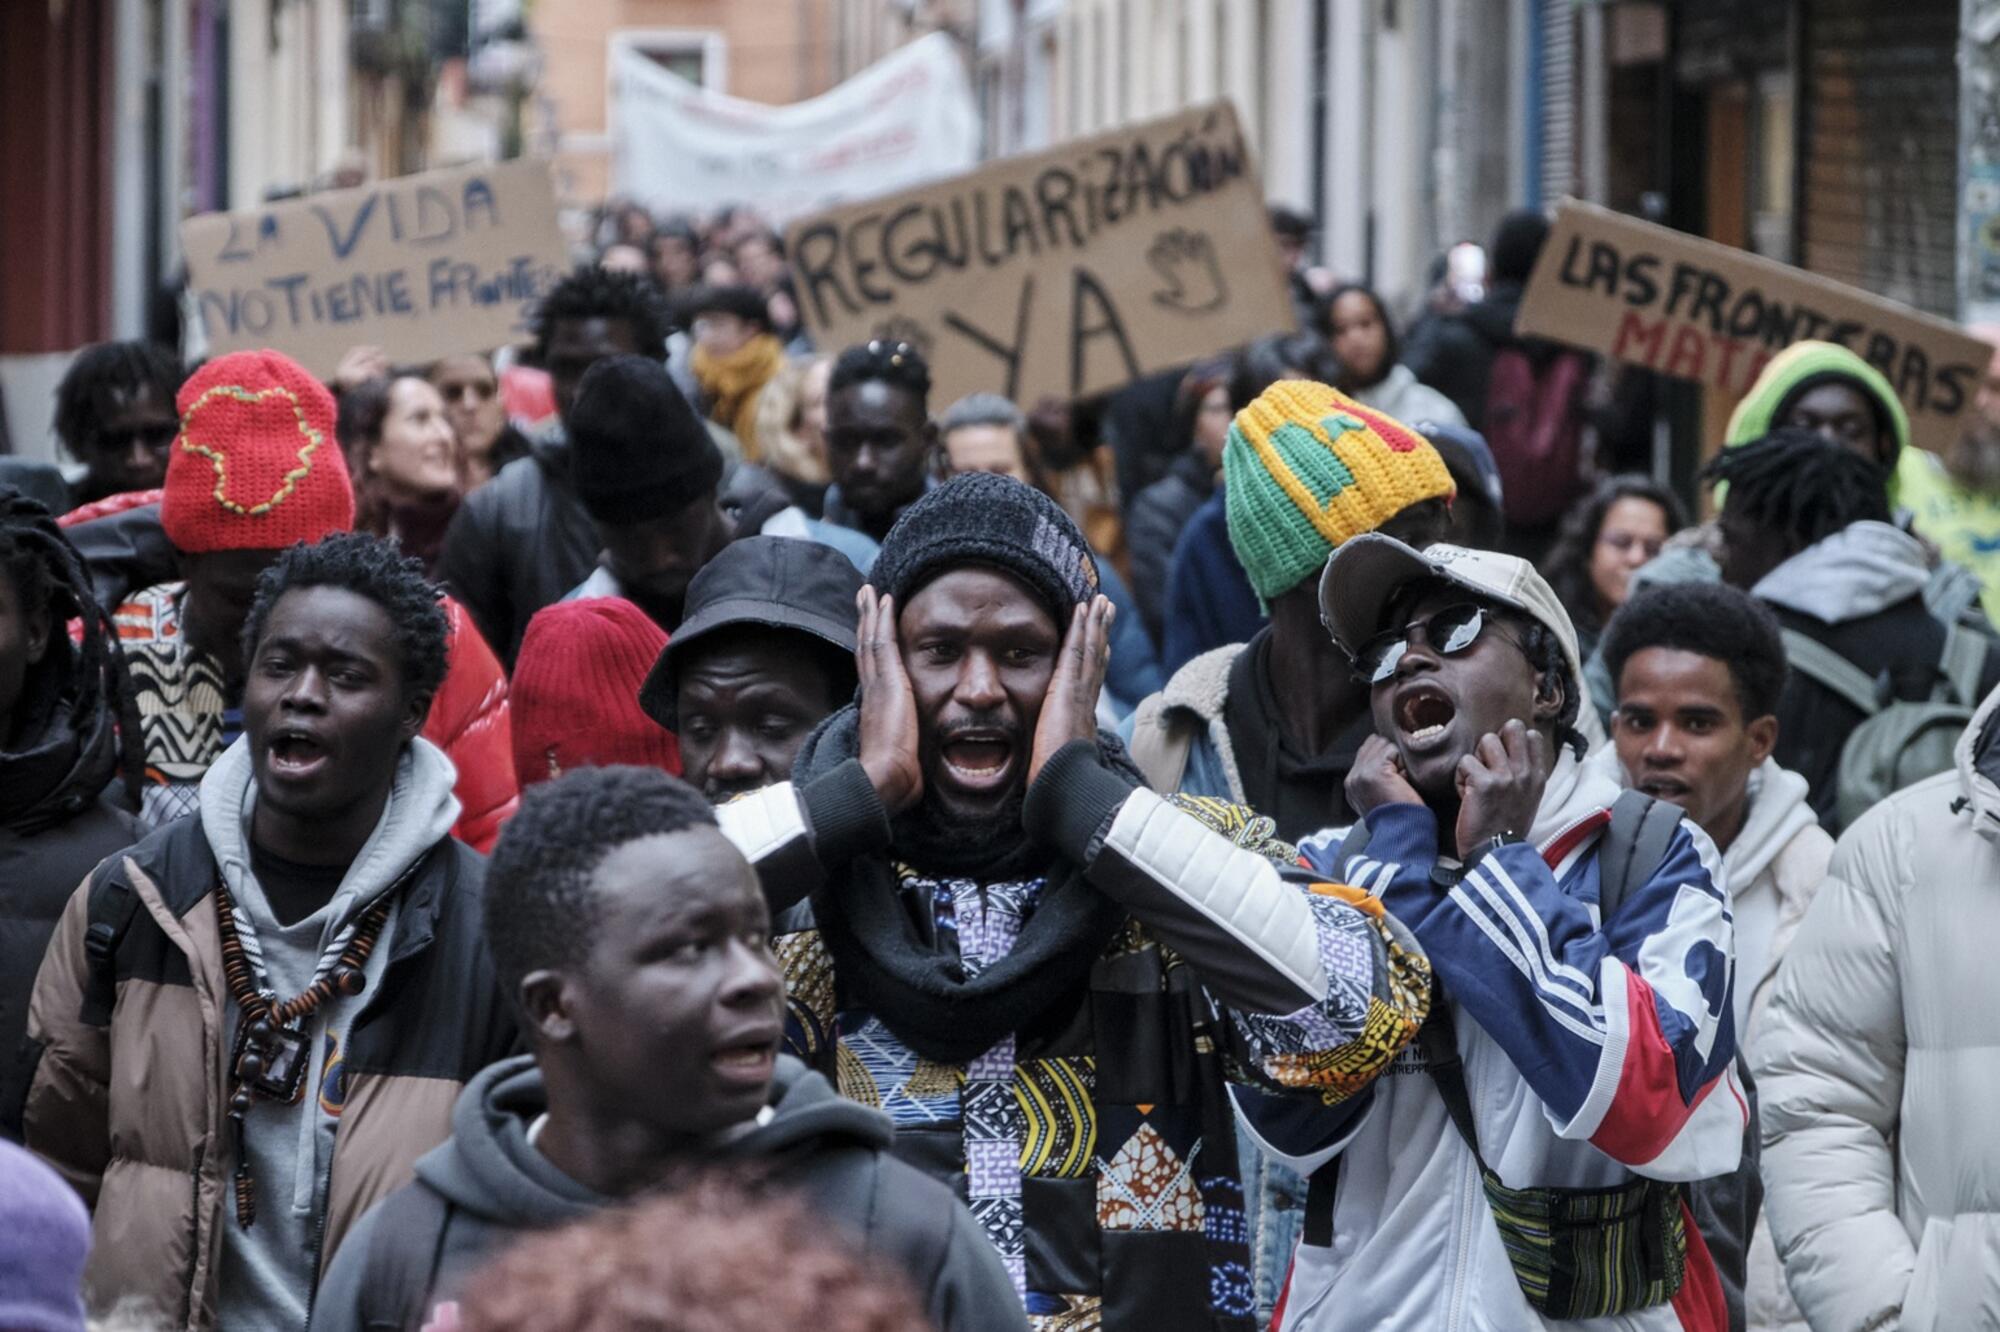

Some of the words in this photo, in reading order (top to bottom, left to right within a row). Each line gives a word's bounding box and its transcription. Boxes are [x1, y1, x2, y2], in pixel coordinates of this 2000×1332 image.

[310, 177, 500, 260] VIDA
[1558, 235, 1661, 306] LAS
[942, 268, 1141, 403] YA
